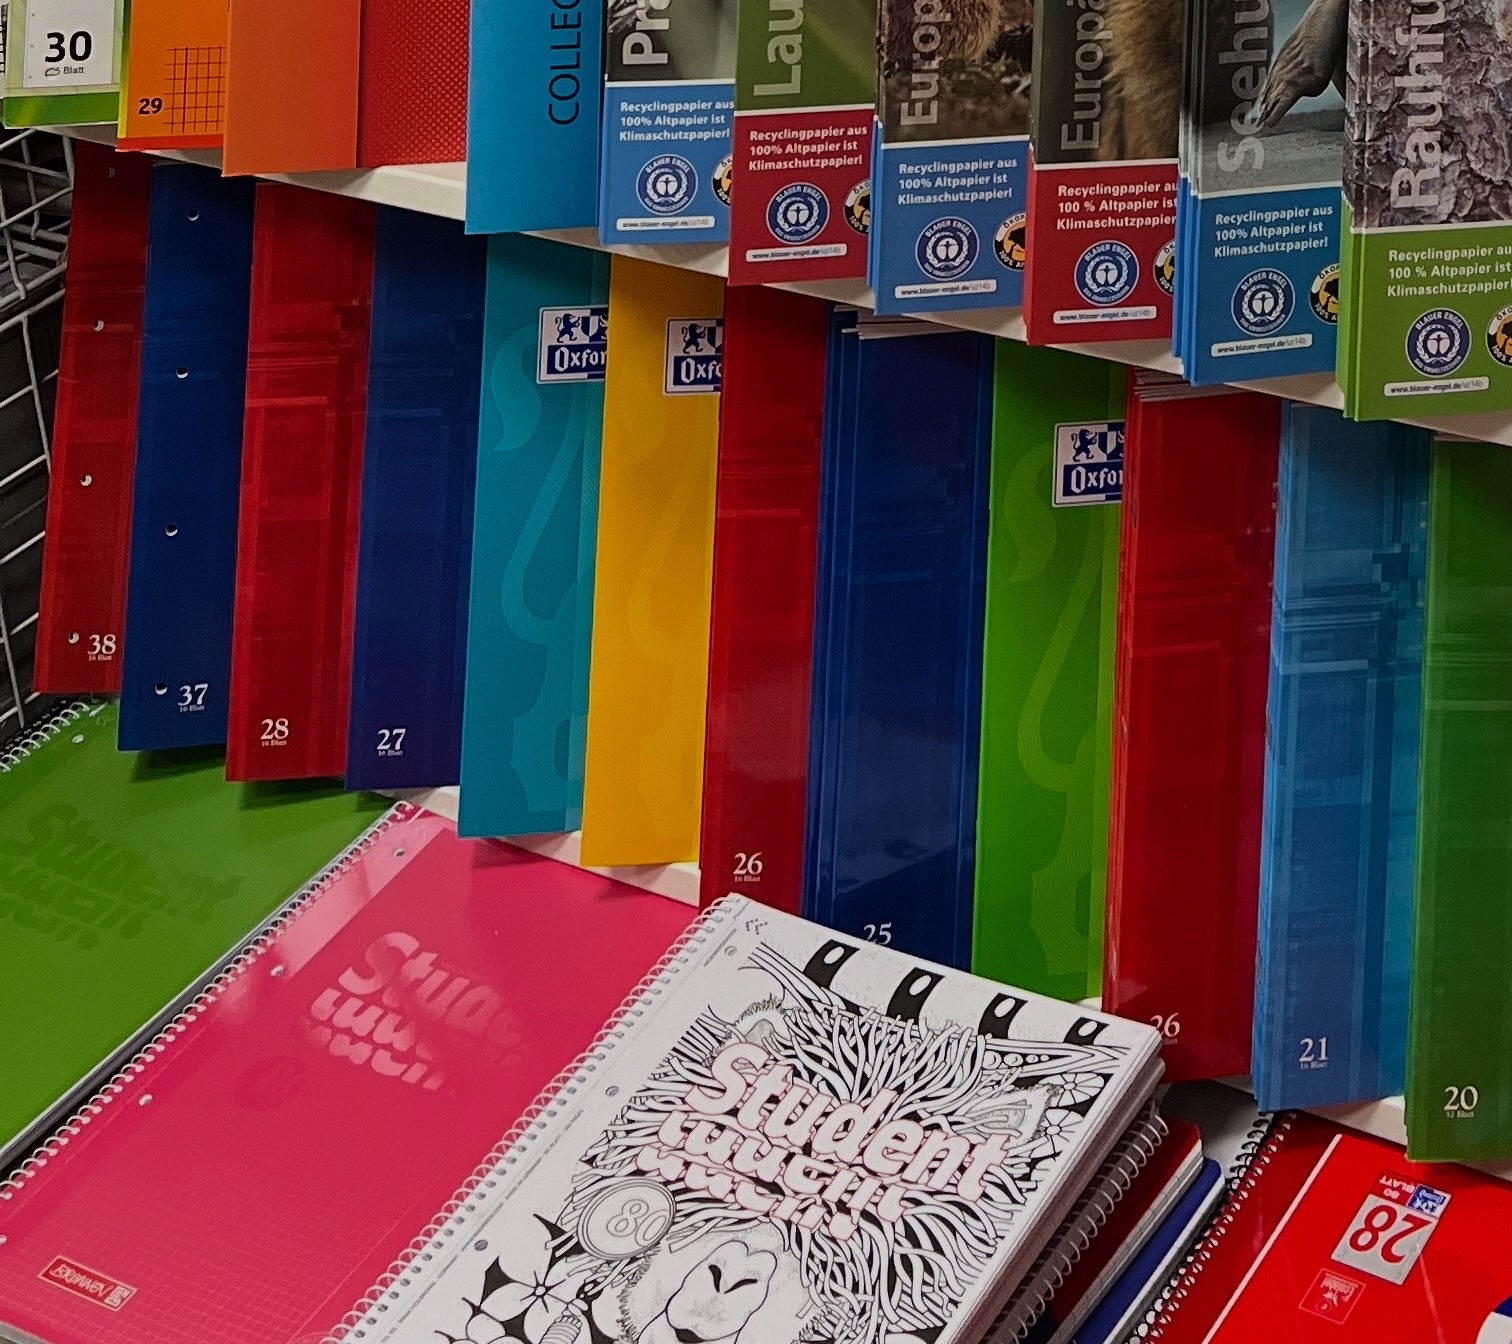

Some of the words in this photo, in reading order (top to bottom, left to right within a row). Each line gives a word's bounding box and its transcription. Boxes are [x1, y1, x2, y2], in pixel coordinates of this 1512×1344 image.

[44, 31, 91, 63] 30
[63, 65, 84, 74] Blatt
[138, 96, 163, 115] 29
[620, 99, 713, 113] Recyclingpapier
[715, 100, 735, 110] aus
[620, 115, 652, 127] 100%
[655, 115, 708, 129] Altpapier
[711, 114, 726, 125] ist
[619, 127, 731, 143] Klimaschutzpapier!
[750, 128, 842, 143] Recyclingpapier
[846, 125, 868, 136] aus
[750, 143, 783, 156] 100%
[785, 141, 840, 157] Altpapier
[843, 140, 858, 152] ist
[749, 154, 863, 173] Klimaschutzpapier!
[898, 159, 995, 175] Recyclingpapier
[997, 157, 1018, 168] aus
[898, 177, 932, 190] 100%
[934, 174, 991, 190] Altpapier
[993, 173, 1008, 185] ist
[1057, 183, 1161, 197] Recyclingpapier
[898, 187, 1013, 205] Klimaschutzpapier!
[1058, 201, 1080, 213] 100
[1099, 200, 1159, 213] Altpapier
[1215, 207, 1310, 225] Recyclingpapier
[1312, 205, 1333, 217] aus
[1056, 215, 1177, 231] Klimaschutzpapier
[1215, 229, 1248, 241] 100%
[1250, 223, 1306, 239] Altpapier
[1308, 221, 1323, 233] ist
[1214, 238, 1329, 258] Klimaschutzpapier!
[1388, 247, 1494, 263] Recyclingpapier
[1389, 268, 1412, 279] 100
[1415, 266, 1428, 278] %
[1431, 263, 1492, 280] Altpapier
[1495, 262, 1512, 274] ist
[88, 633, 117, 655] 38
[178, 683, 209, 707] 37
[260, 718, 289, 741] 28
[377, 727, 407, 752] 27
[733, 851, 763, 876] 26
[863, 922, 892, 942] 25
[1150, 1012, 1181, 1038] 26
[1299, 1036, 1330, 1062] 21
[1443, 1085, 1479, 1111] 20
[684, 1041, 1011, 1202] Student
[1347, 1204, 1434, 1265] 28
